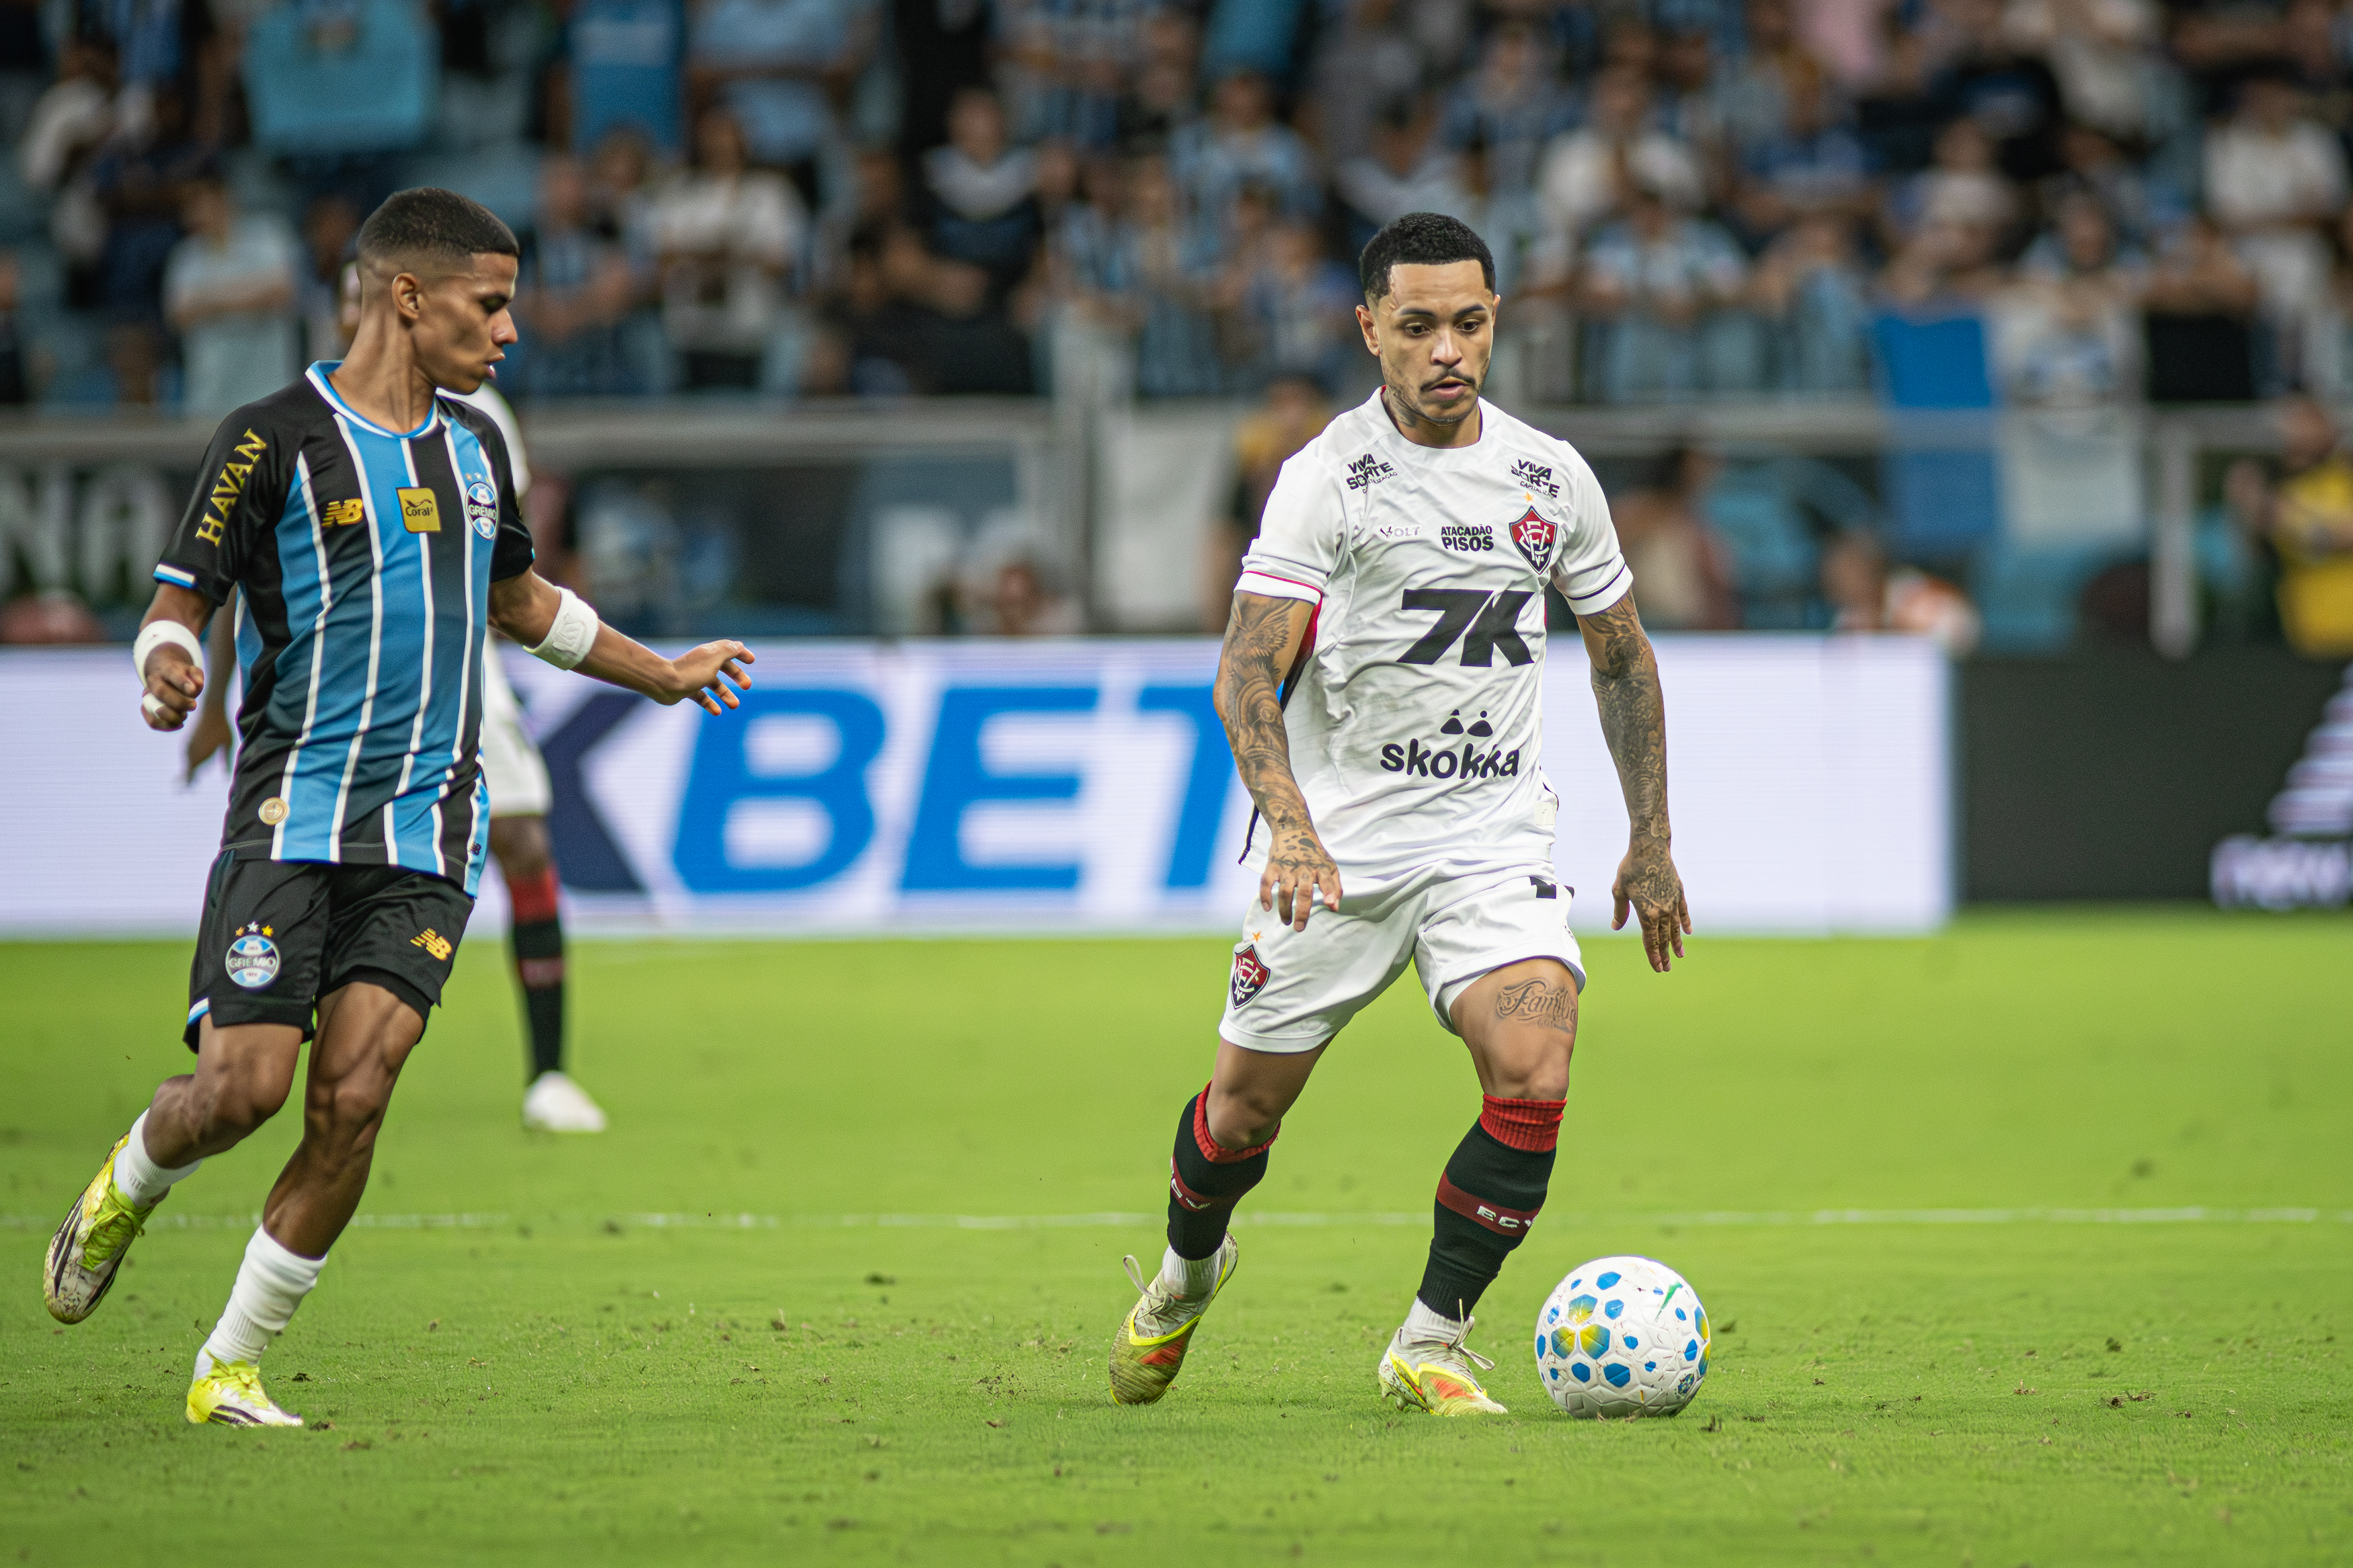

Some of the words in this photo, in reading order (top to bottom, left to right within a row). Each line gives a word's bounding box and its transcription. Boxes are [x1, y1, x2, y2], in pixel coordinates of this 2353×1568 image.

[1347, 453, 1376, 474] VIVA
[1517, 458, 1552, 481] VIVA
[1346, 461, 1394, 490] SORTE
[196, 427, 267, 547] HAVAN
[405, 506, 430, 516] Coral
[1380, 526, 1420, 538] VOLT
[1441, 524, 1492, 536] ATACADÃO
[1441, 536, 1494, 552] PISOS
[1396, 588, 1535, 667] 7K
[1380, 738, 1520, 780] skokka
